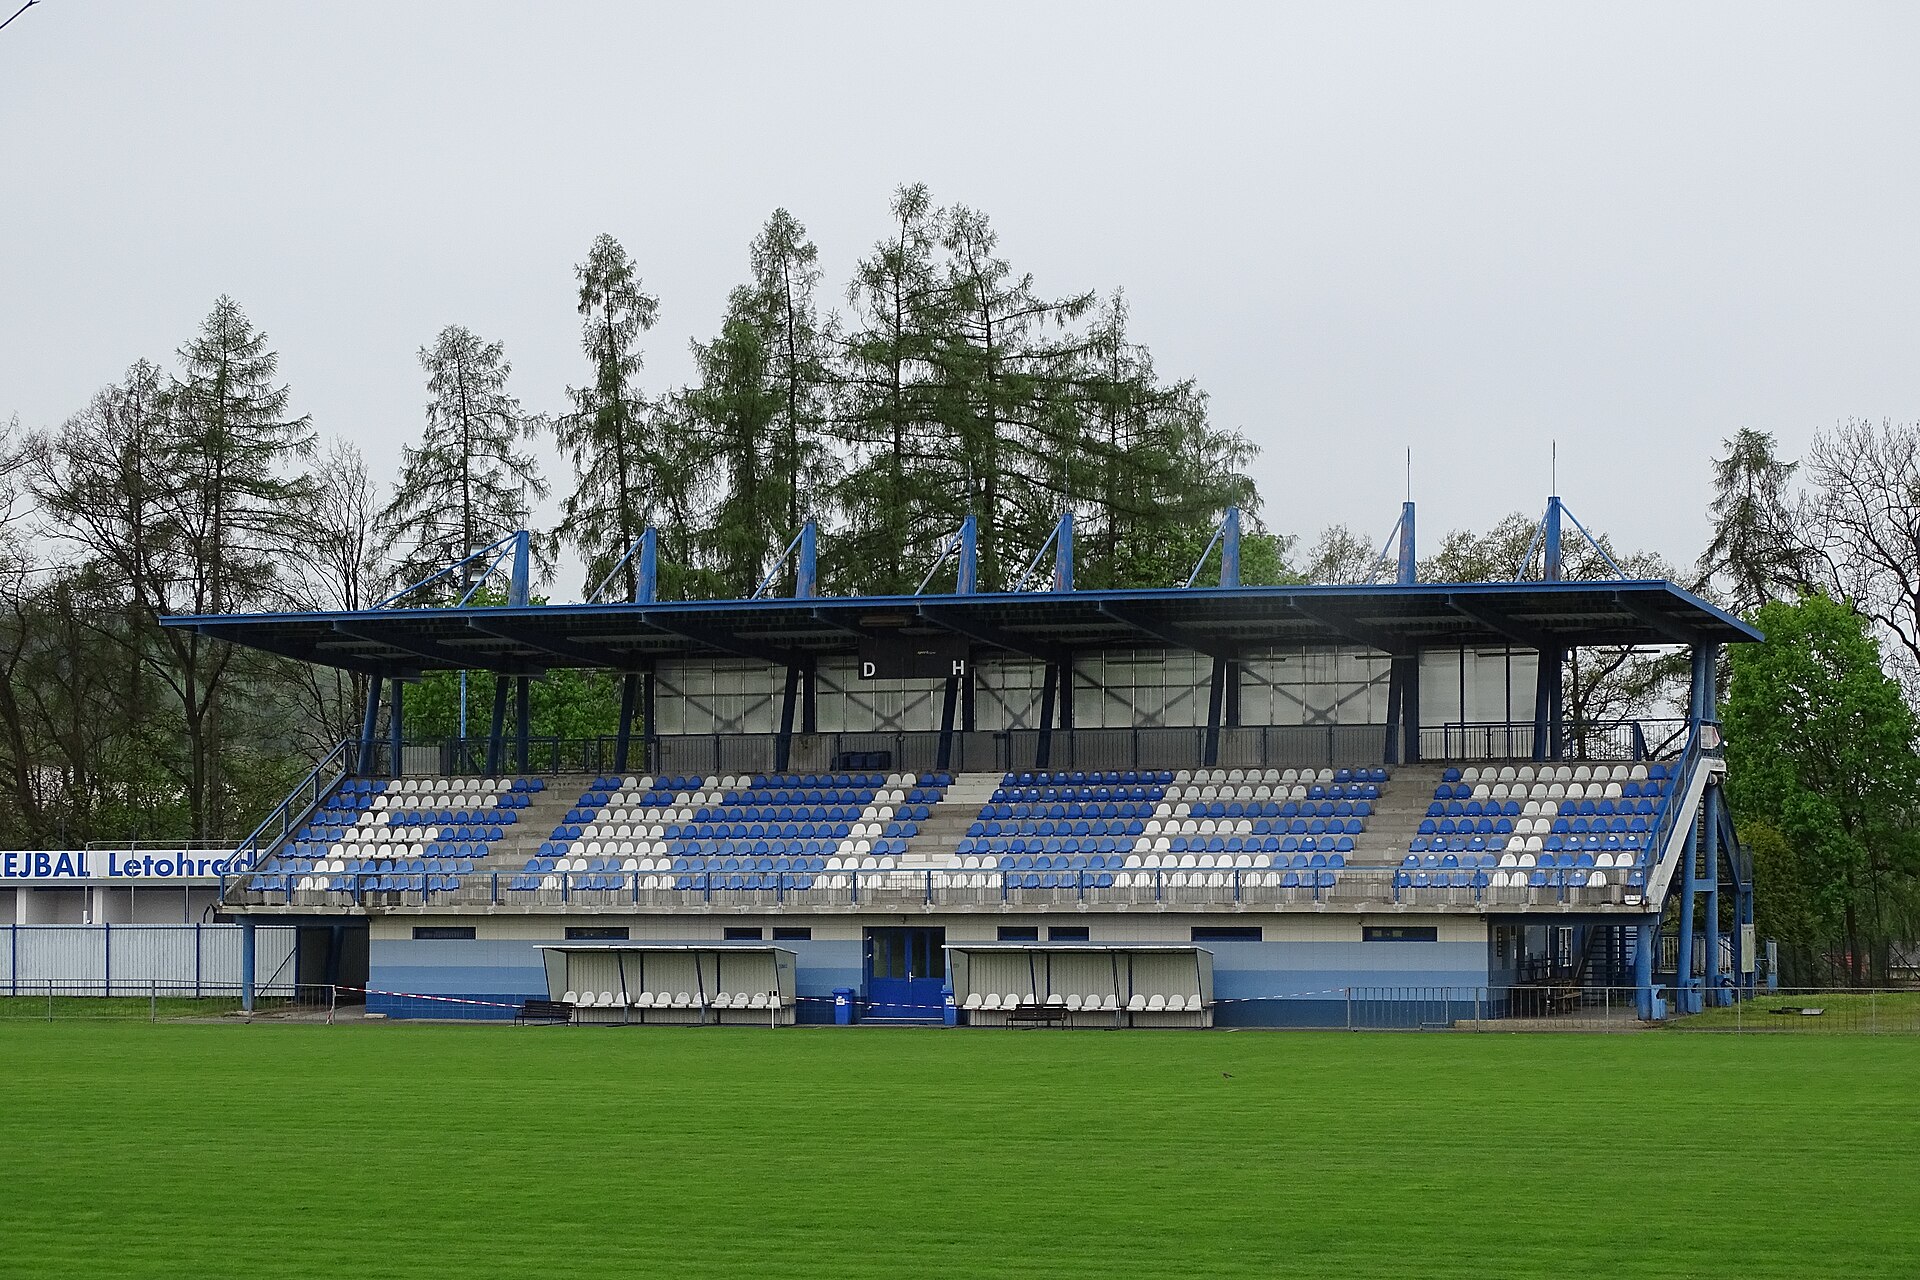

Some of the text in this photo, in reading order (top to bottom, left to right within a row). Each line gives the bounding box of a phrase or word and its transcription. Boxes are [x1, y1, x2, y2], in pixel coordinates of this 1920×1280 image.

[863, 662, 876, 677] D
[952, 660, 965, 675] H
[0, 852, 91, 877] EJBAL
